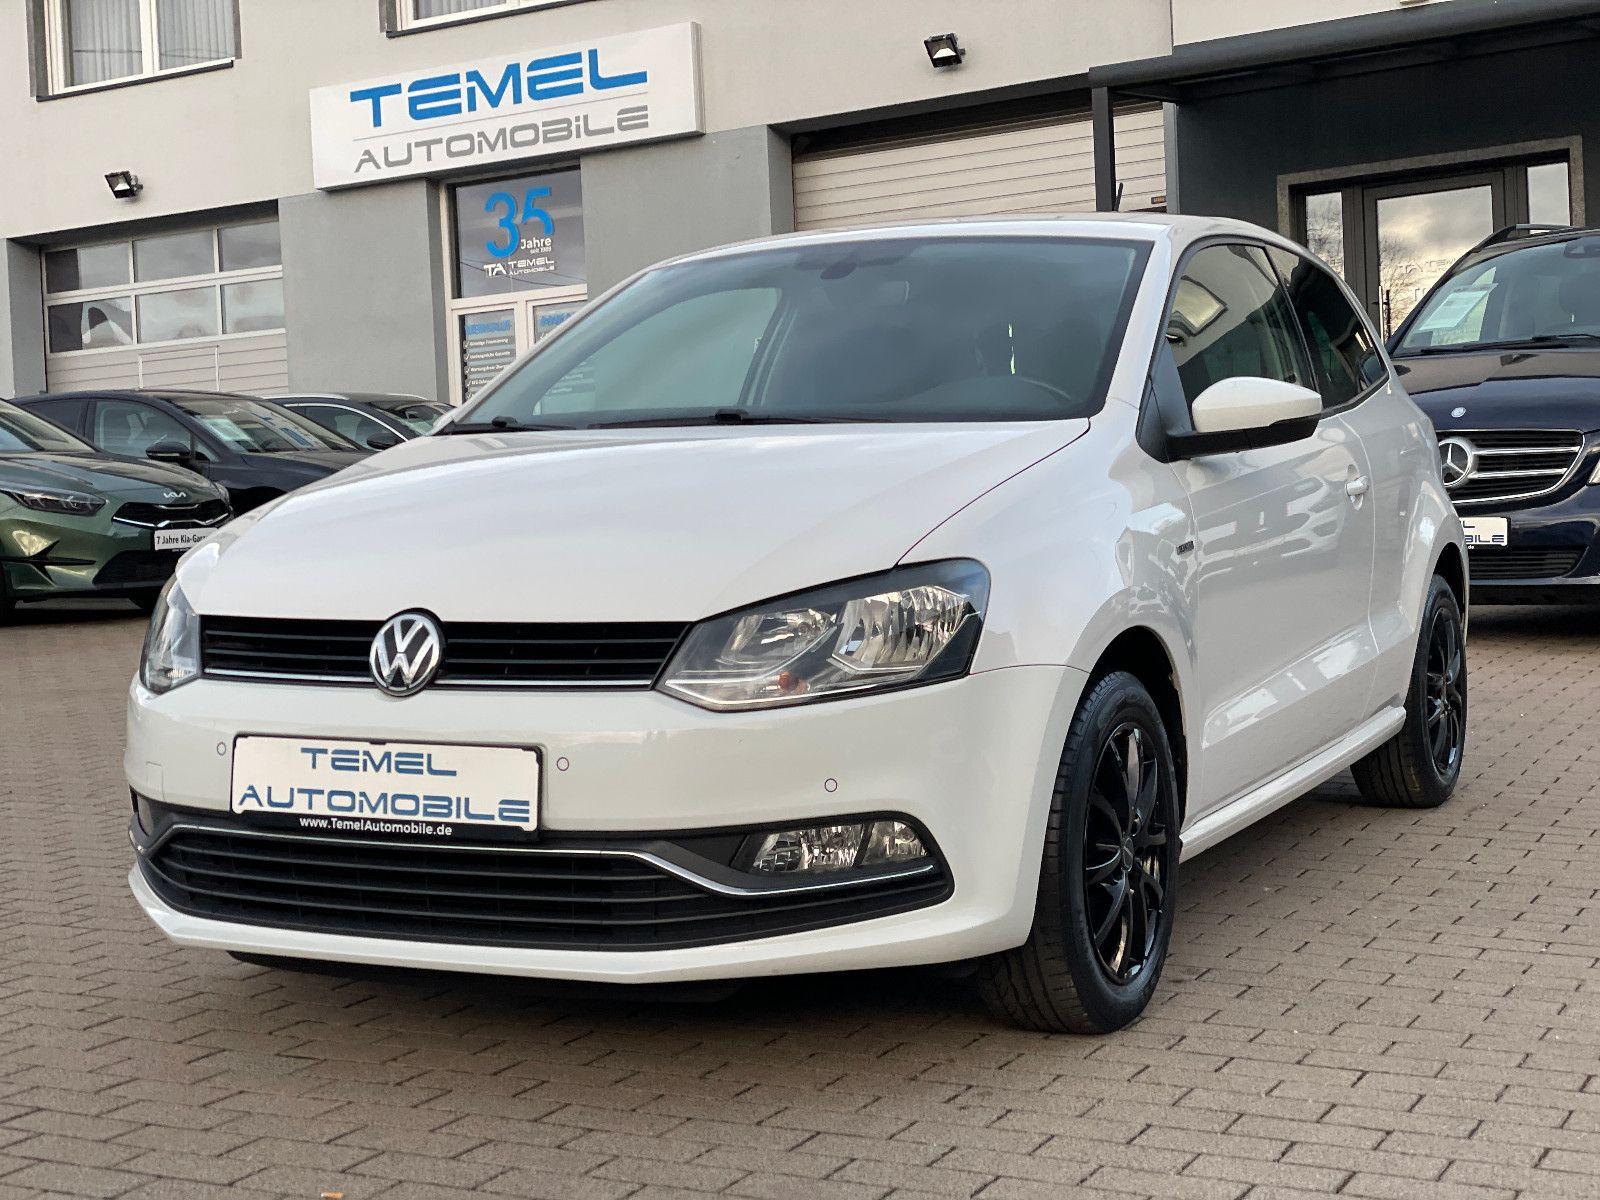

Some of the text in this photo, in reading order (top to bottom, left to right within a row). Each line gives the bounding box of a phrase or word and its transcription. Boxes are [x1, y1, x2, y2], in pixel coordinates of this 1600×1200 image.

[350, 48, 648, 128] TEMEL
[484, 186, 555, 259] 35
[520, 236, 552, 250] Jahre
[507, 256, 555, 269] TEMEL
[156, 536, 161, 544] 7
[162, 534, 179, 544] Jahre
[301, 747, 457, 777] TEMEL
[238, 785, 530, 823] AUTOMOBILE
[300, 817, 453, 836] www.TemelAutomobile.de
